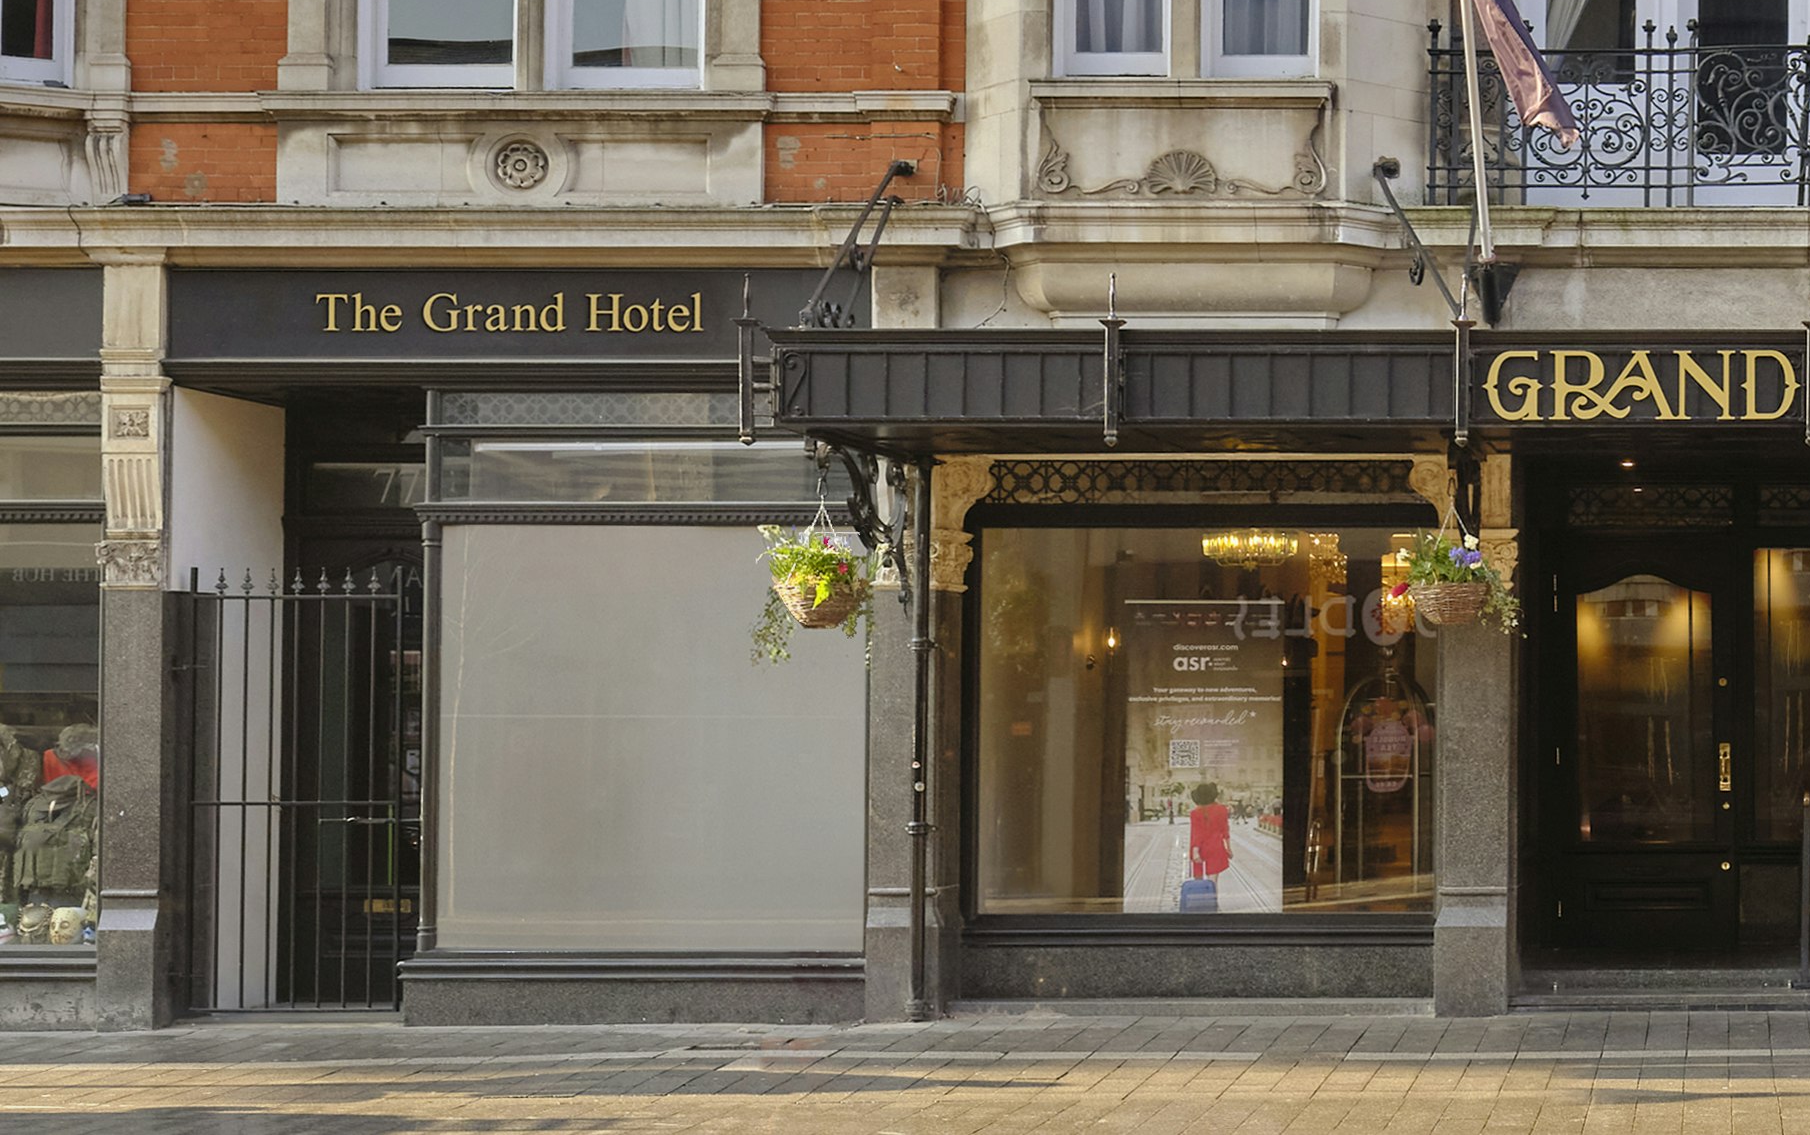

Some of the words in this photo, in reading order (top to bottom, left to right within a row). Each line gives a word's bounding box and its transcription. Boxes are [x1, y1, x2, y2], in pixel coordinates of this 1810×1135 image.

[316, 292, 402, 332] The
[423, 292, 566, 333] Grand
[585, 292, 703, 333] Hotel
[1482, 349, 1800, 421] GRAND
[373, 468, 421, 503] 77
